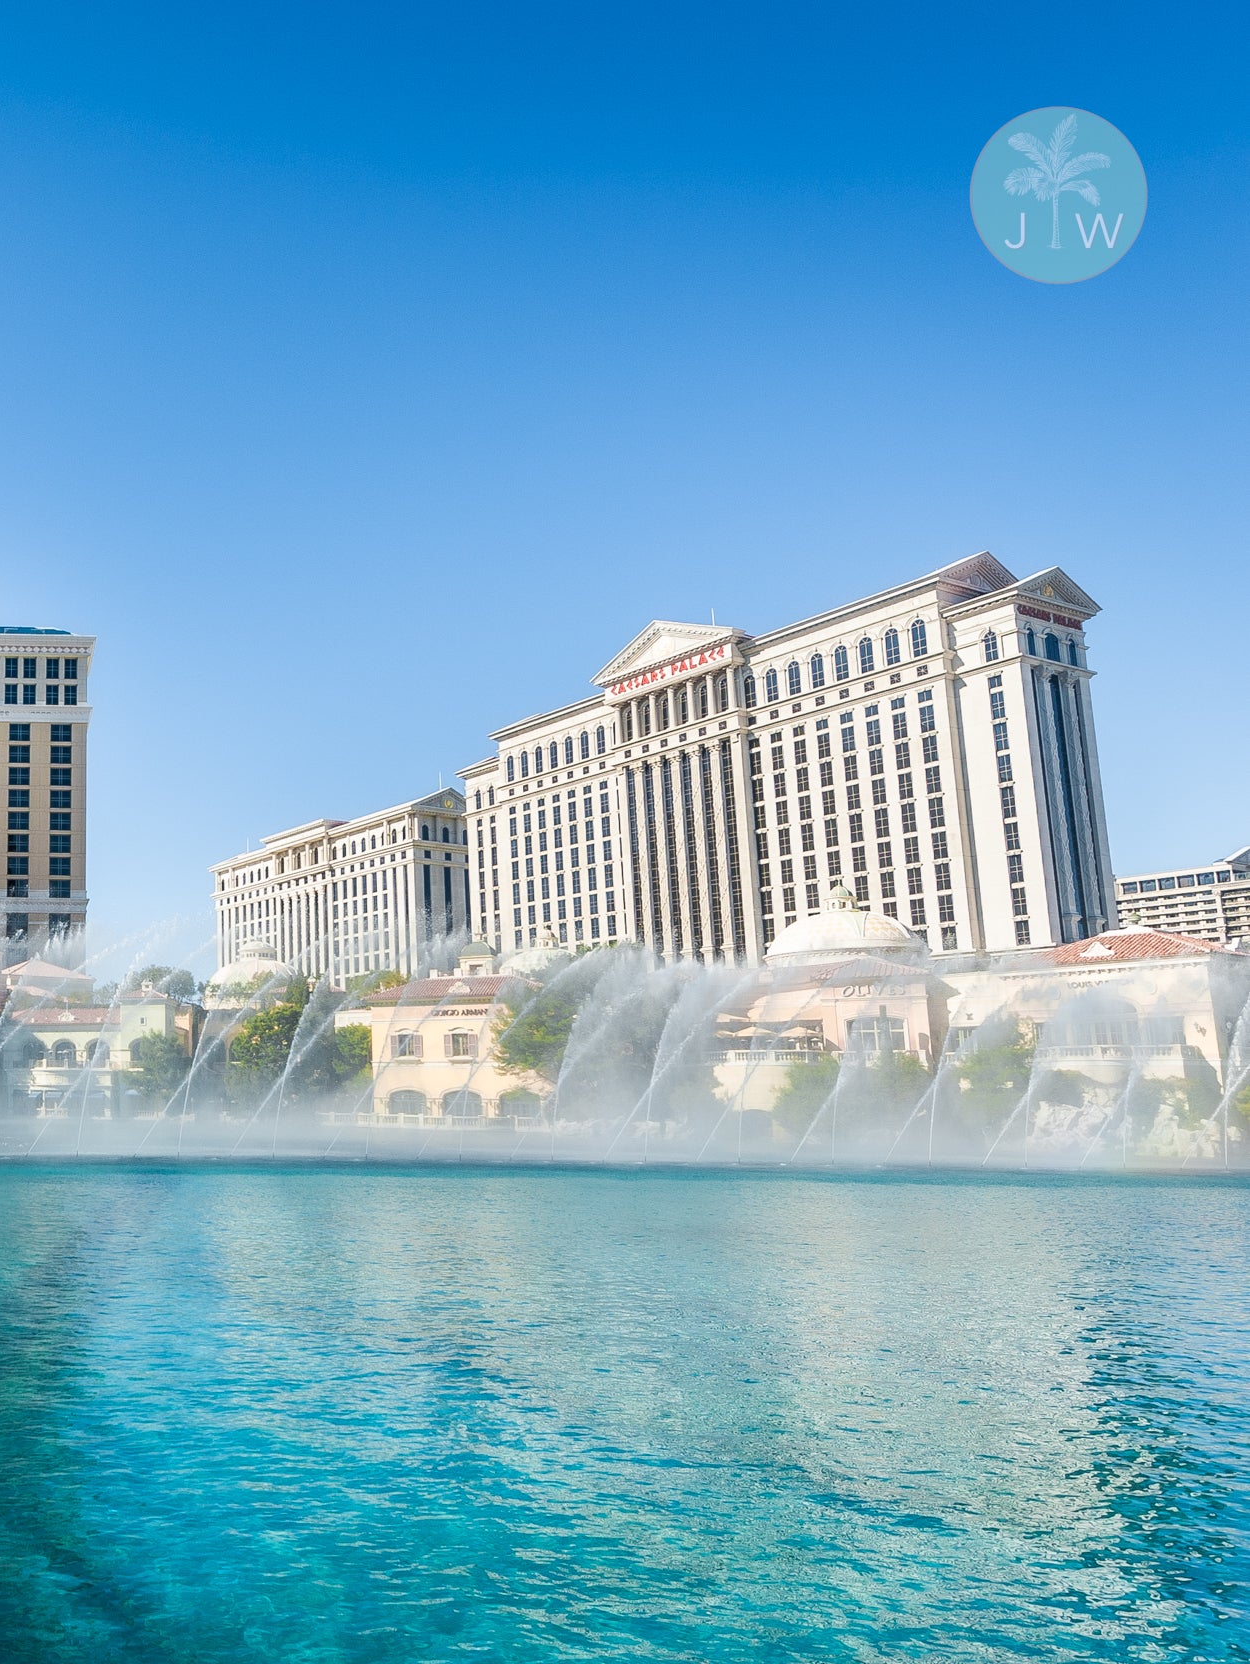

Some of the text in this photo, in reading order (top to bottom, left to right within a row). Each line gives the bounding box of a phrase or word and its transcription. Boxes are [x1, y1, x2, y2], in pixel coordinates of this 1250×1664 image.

[610, 645, 725, 696] CAESARS PALACE
[841, 981, 906, 998] OLIVES
[431, 1008, 460, 1017] GIORGIO
